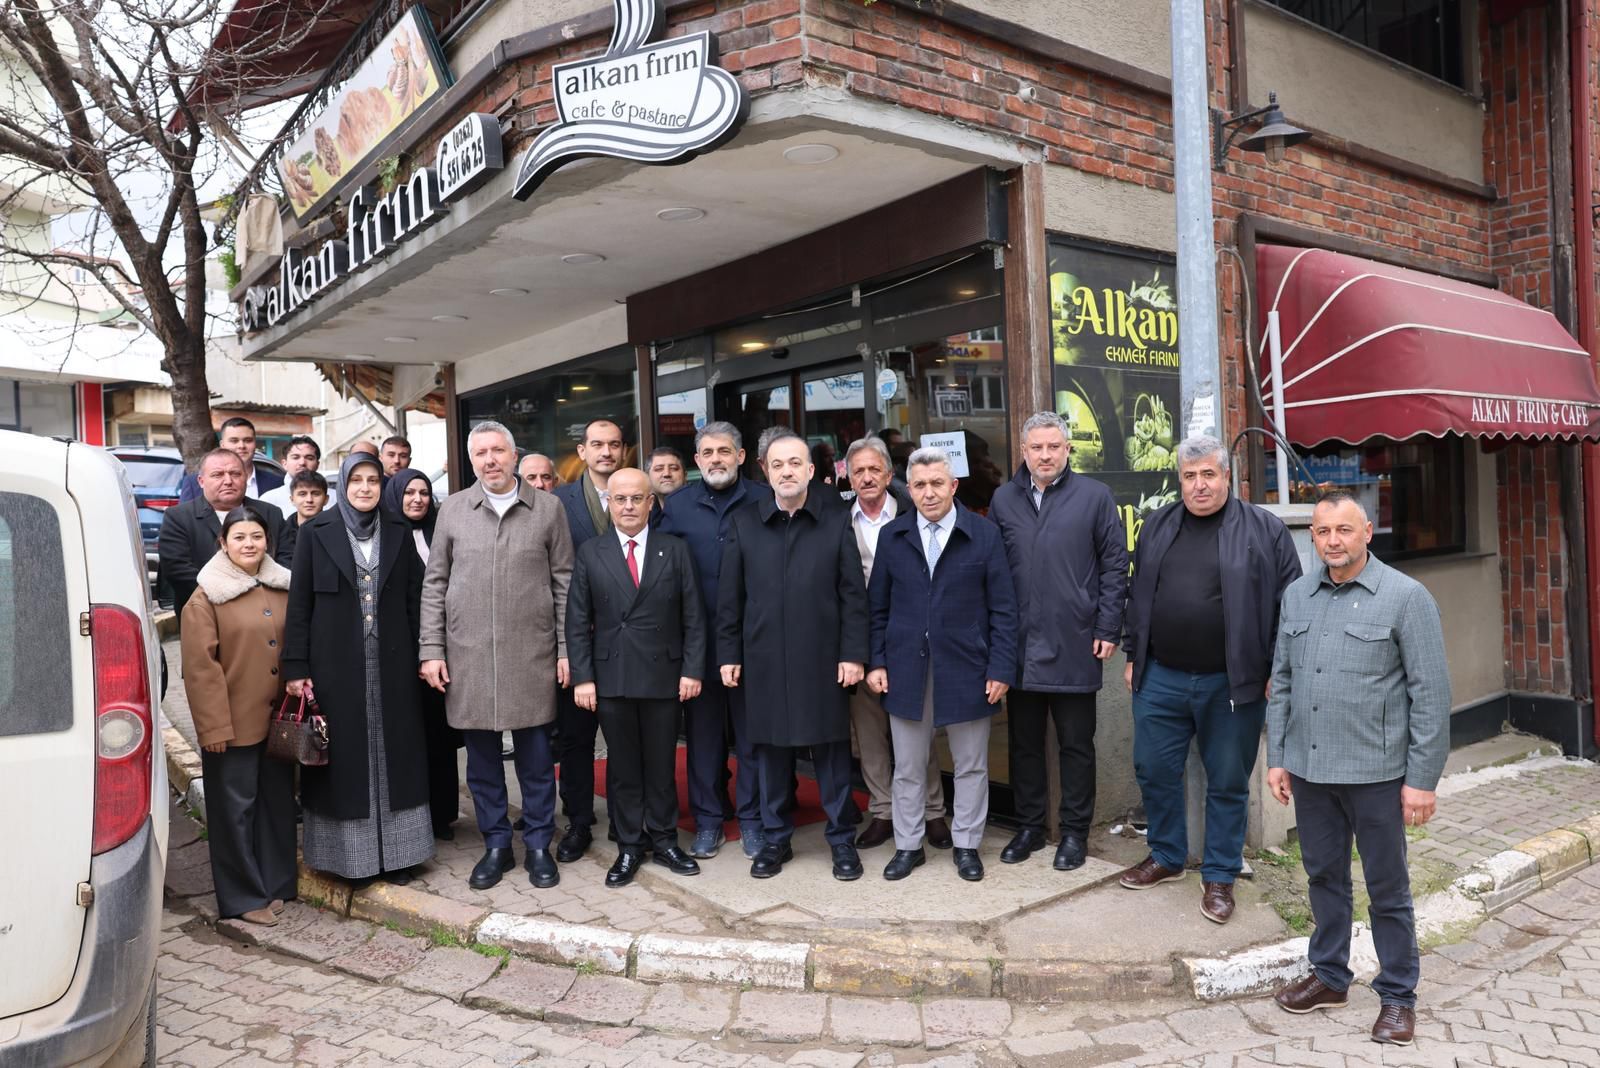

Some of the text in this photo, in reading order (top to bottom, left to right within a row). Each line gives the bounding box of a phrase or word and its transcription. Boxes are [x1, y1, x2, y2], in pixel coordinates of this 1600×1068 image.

[565, 49, 698, 95] alkan fırın
[571, 99, 687, 127] cafe & pastane
[453, 116, 473, 152] (0262)
[447, 135, 483, 188] 551 66 25
[267, 167, 435, 326] alkan fırın
[1067, 286, 1178, 350] Alkan
[1105, 346, 1147, 364] EKMEK
[1471, 398, 1589, 426] ALKAN FIRIN & CAFE
